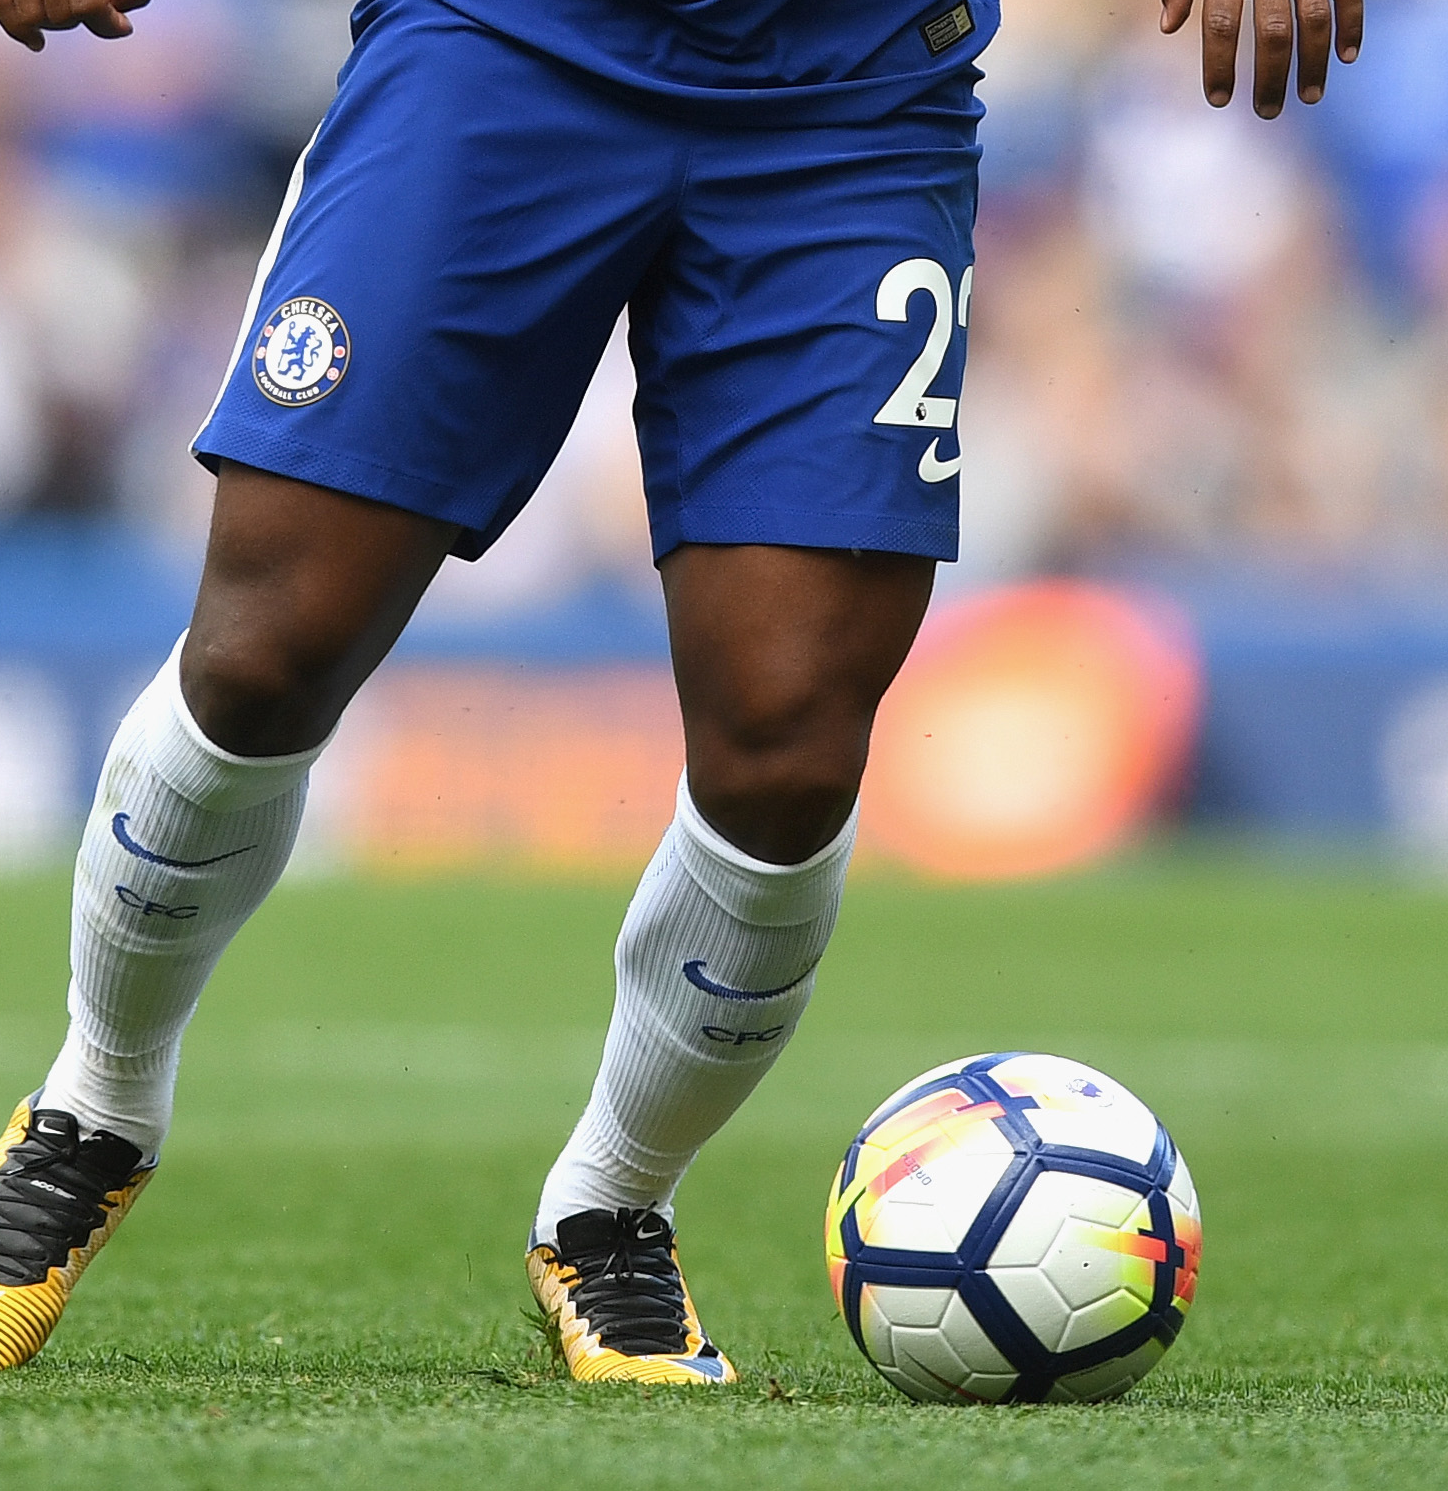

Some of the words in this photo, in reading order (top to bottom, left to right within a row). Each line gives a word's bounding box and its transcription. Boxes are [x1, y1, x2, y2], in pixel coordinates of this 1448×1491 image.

[280, 301, 339, 334] CHELSEA
[873, 257, 974, 429] 2
[258, 371, 293, 400] FOOTBALL
[296, 386, 320, 400] CLUB
[115, 885, 200, 919] CFC
[702, 1025, 785, 1046] CFC
